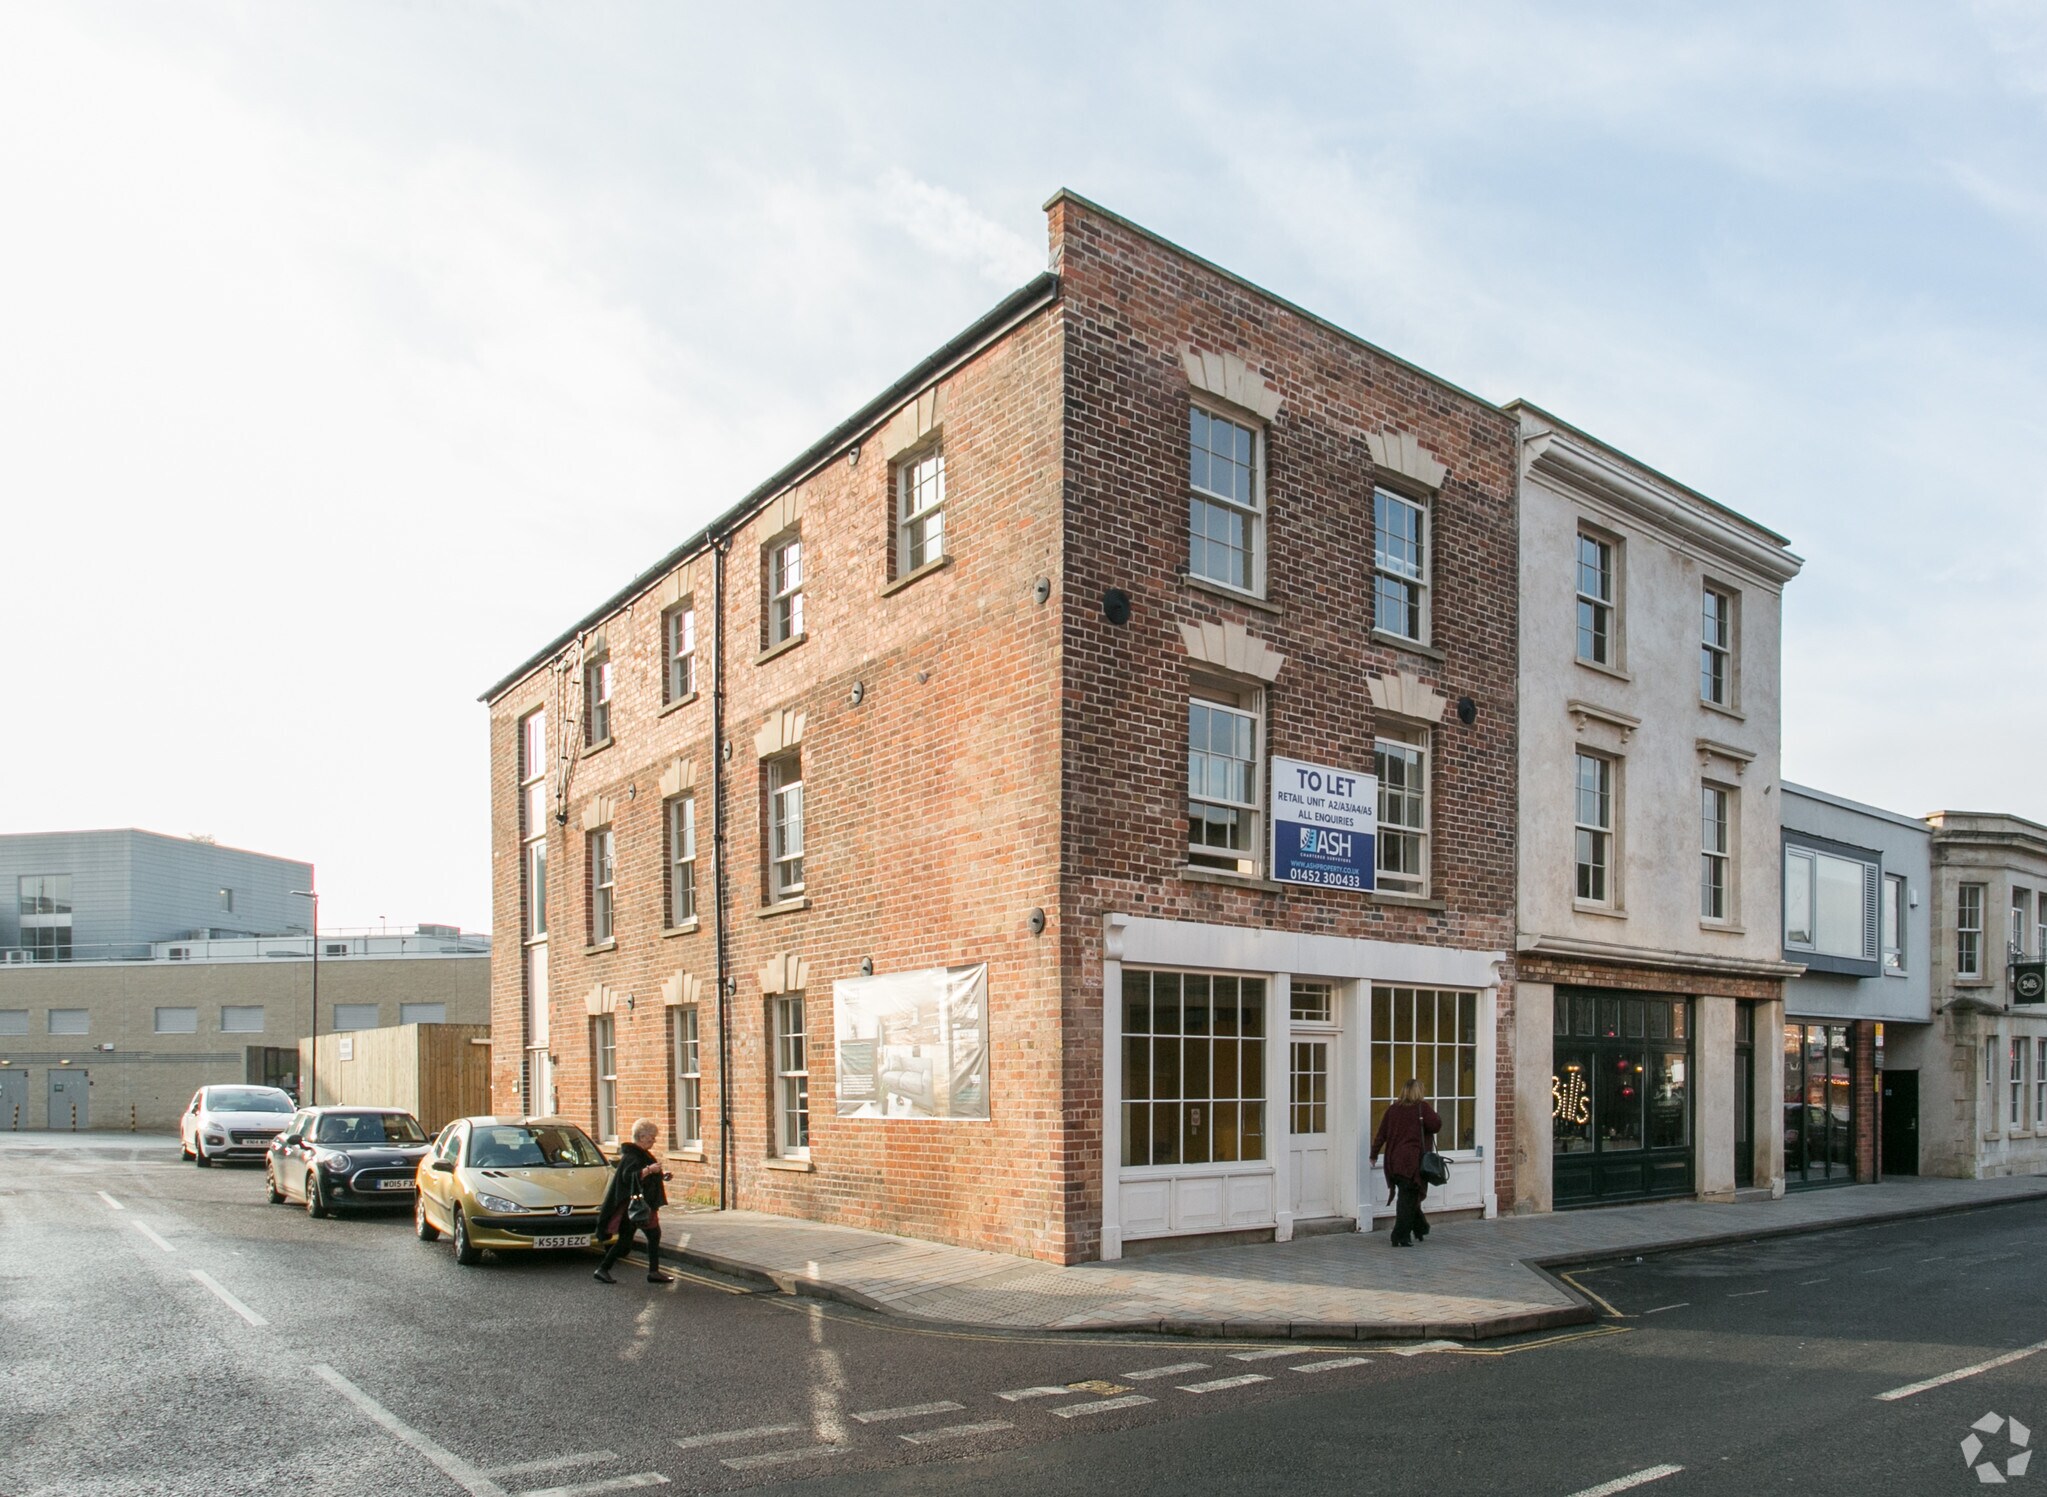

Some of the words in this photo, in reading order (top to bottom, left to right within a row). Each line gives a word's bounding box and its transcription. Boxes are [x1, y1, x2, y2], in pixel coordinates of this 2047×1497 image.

[1297, 768, 1322, 792] TO
[1327, 774, 1356, 798] LET
[1278, 791, 1304, 805] RETAIL
[1307, 795, 1325, 808] UNIT
[1328, 800, 1372, 816] A2/A3/A4/A5
[1298, 809, 1312, 821] ALL
[1315, 812, 1354, 827] ENQUIRIES
[1317, 830, 1351, 858] ASH
[1290, 860, 1360, 875] WWW.ASHPROPERTY.CO.UK
[1290, 867, 1320, 883] 01452
[1323, 872, 1360, 887] 300433
[538, 1237, 565, 1247] KS53
[567, 1236, 587, 1246] EZC
